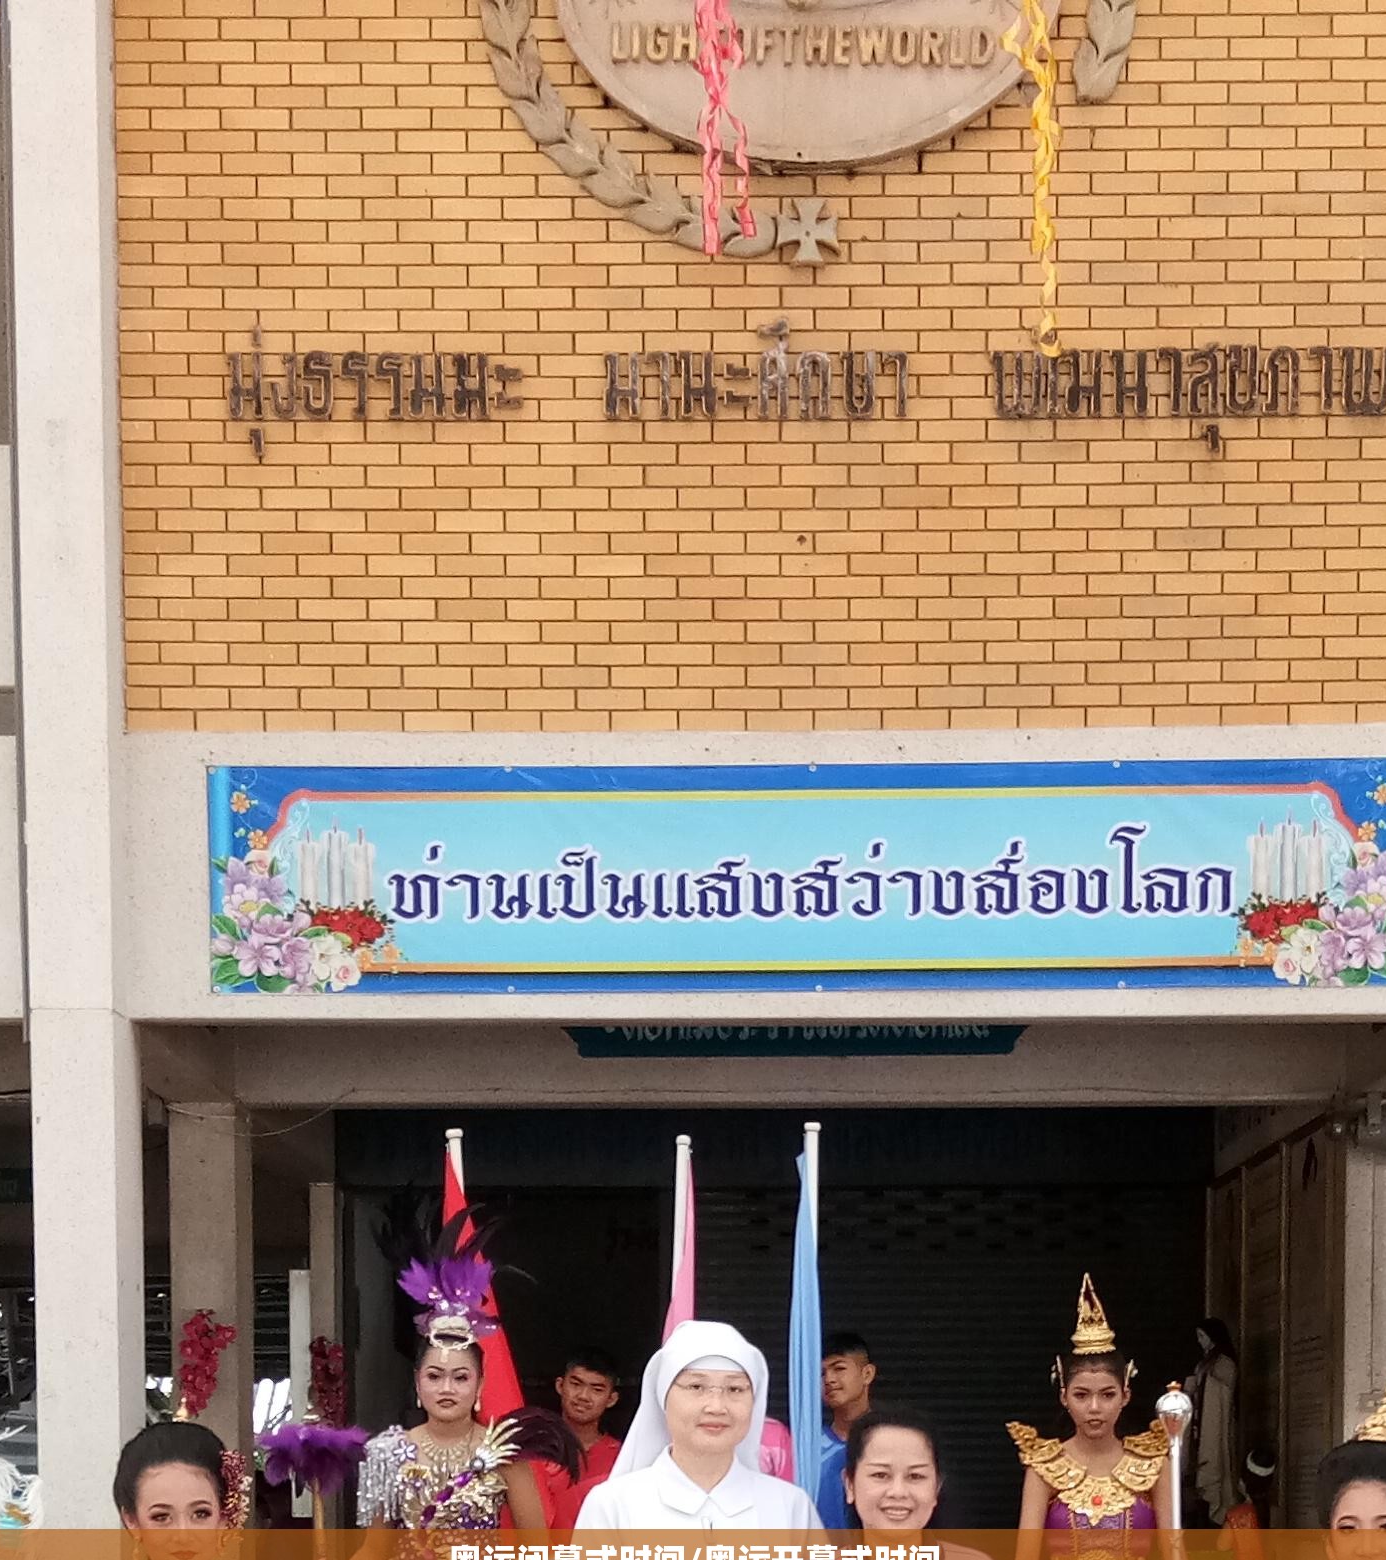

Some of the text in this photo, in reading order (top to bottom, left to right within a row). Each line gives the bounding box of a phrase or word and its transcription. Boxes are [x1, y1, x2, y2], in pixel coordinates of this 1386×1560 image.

[387, 824, 1235, 922] ท่านเป็นแสงสว่างส่องโลก
